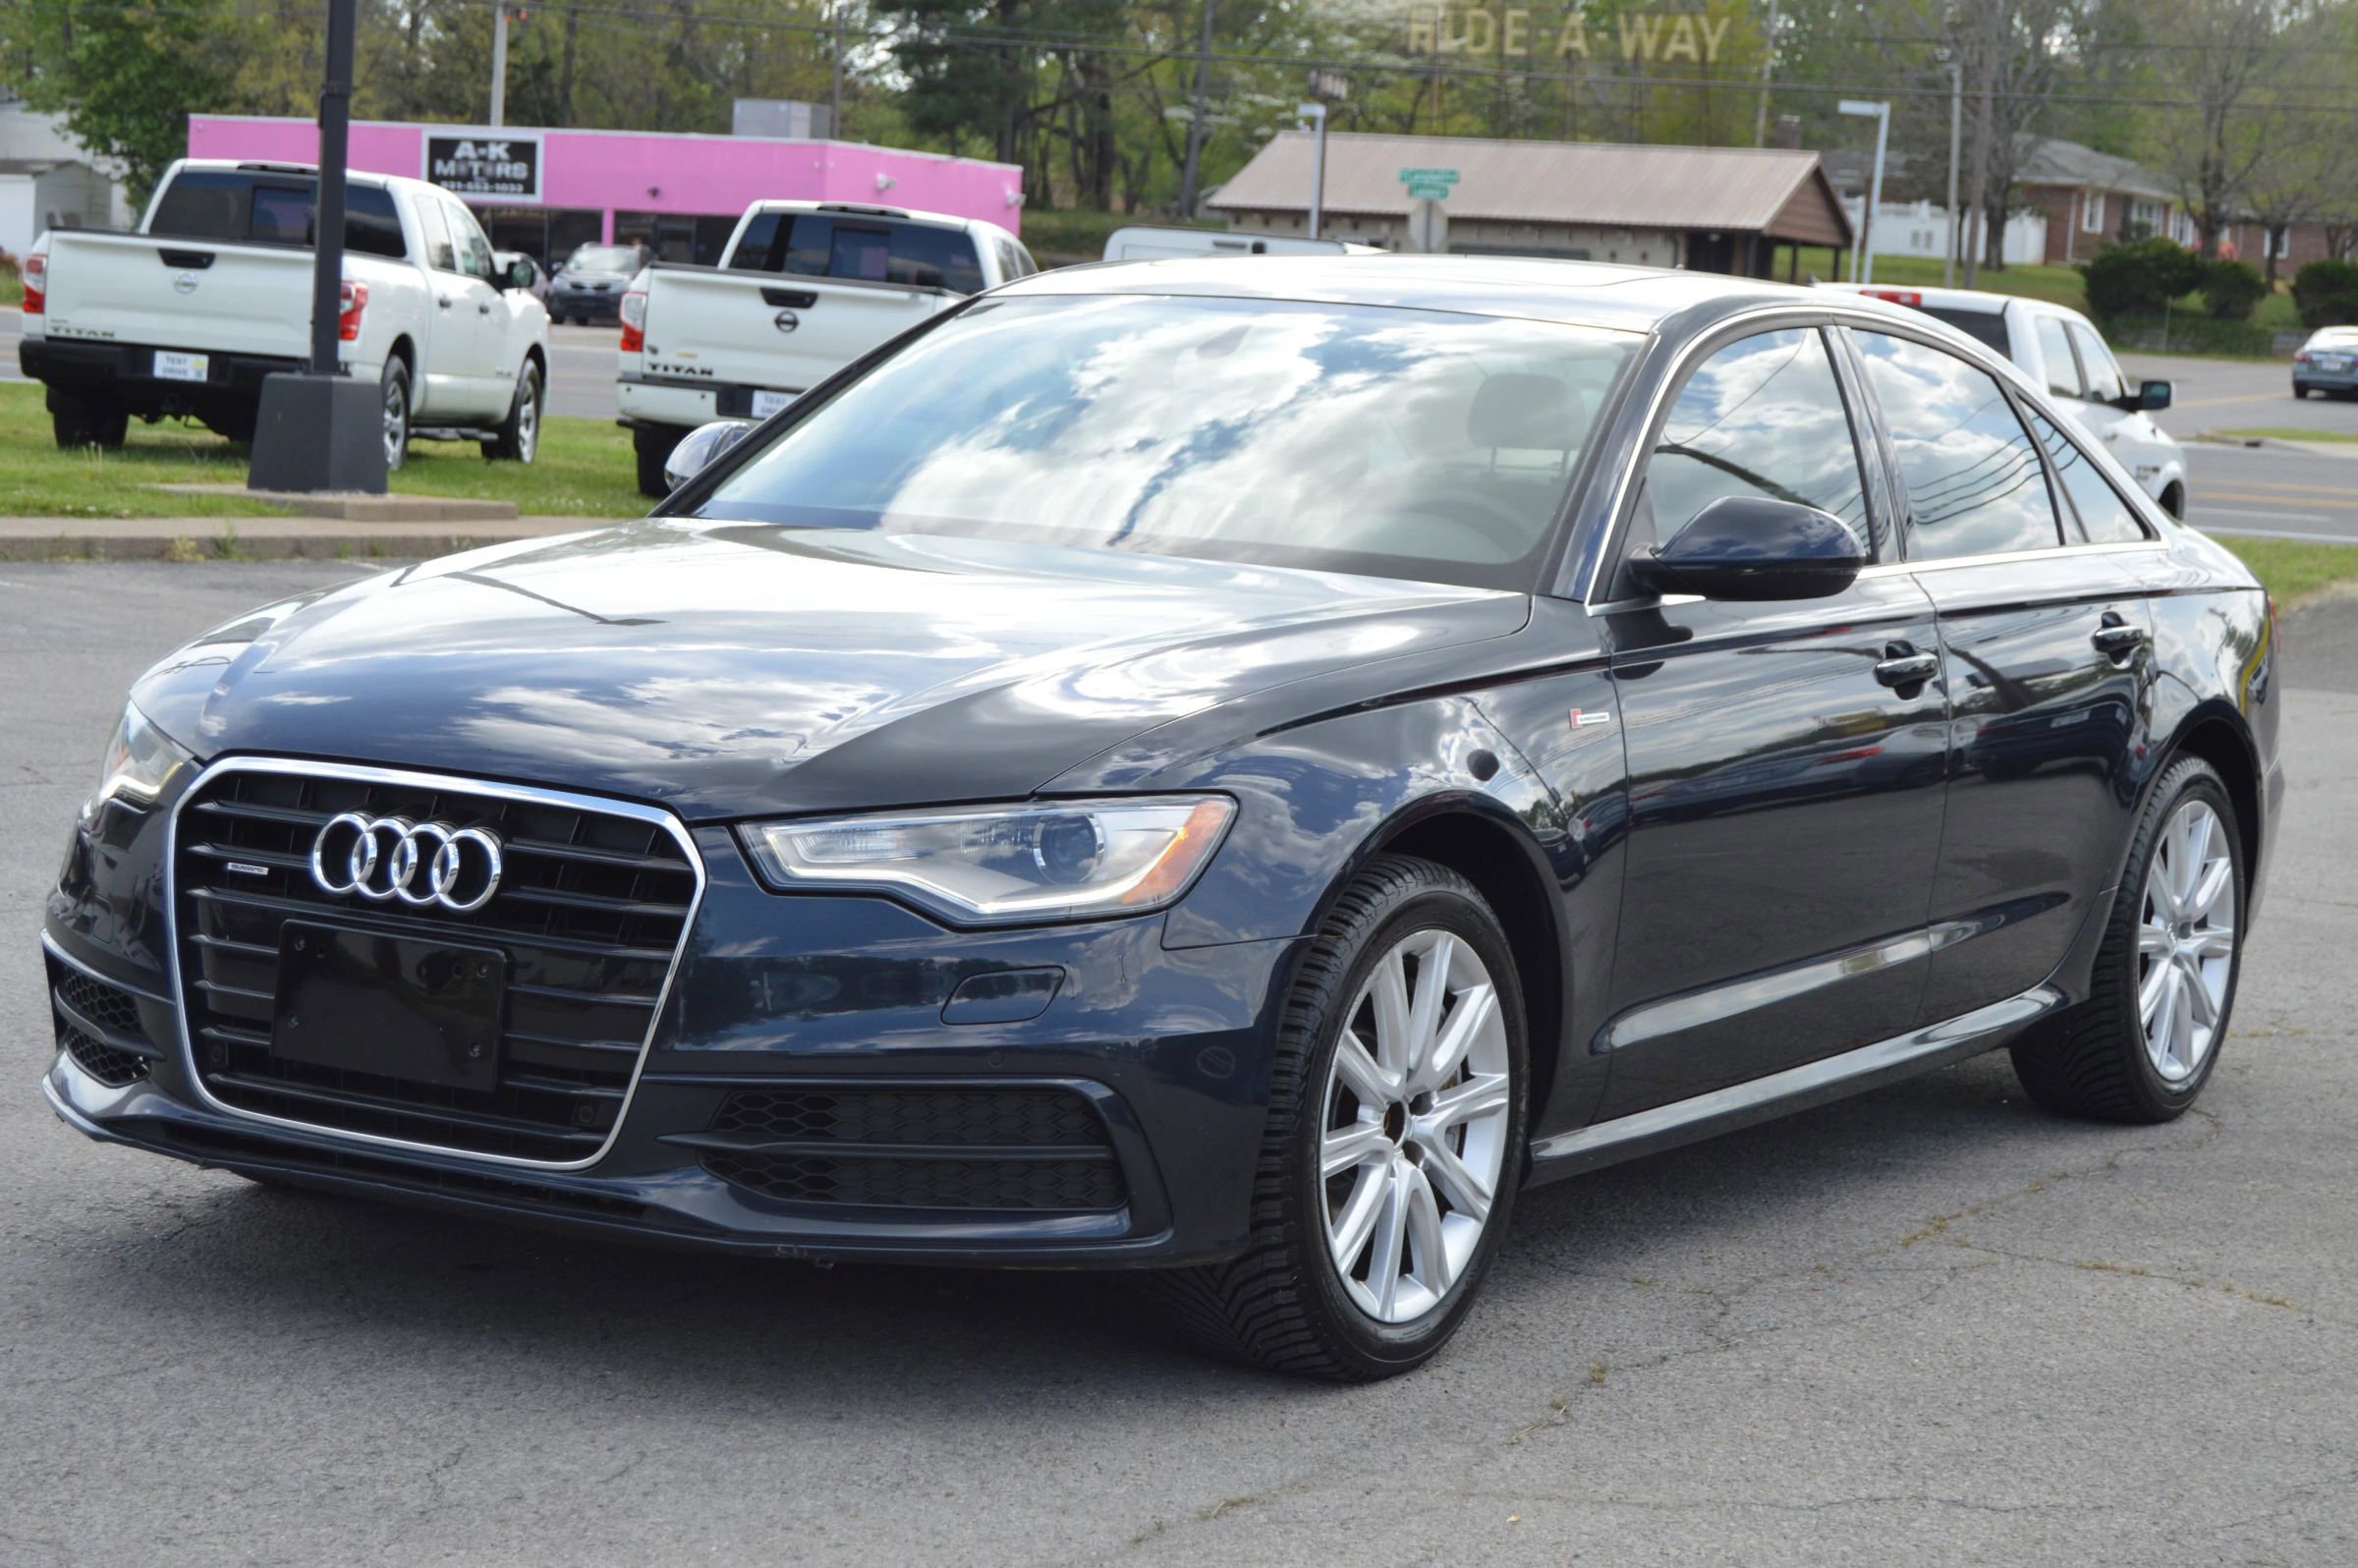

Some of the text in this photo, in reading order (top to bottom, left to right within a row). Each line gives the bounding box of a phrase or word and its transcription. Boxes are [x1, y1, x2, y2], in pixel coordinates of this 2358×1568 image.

[454, 140, 511, 161] A-K
[50, 325, 116, 339] TITAN
[165, 354, 189, 366] TEST
[161, 365, 189, 378] DRIVE
[646, 362, 714, 377] TITAN
